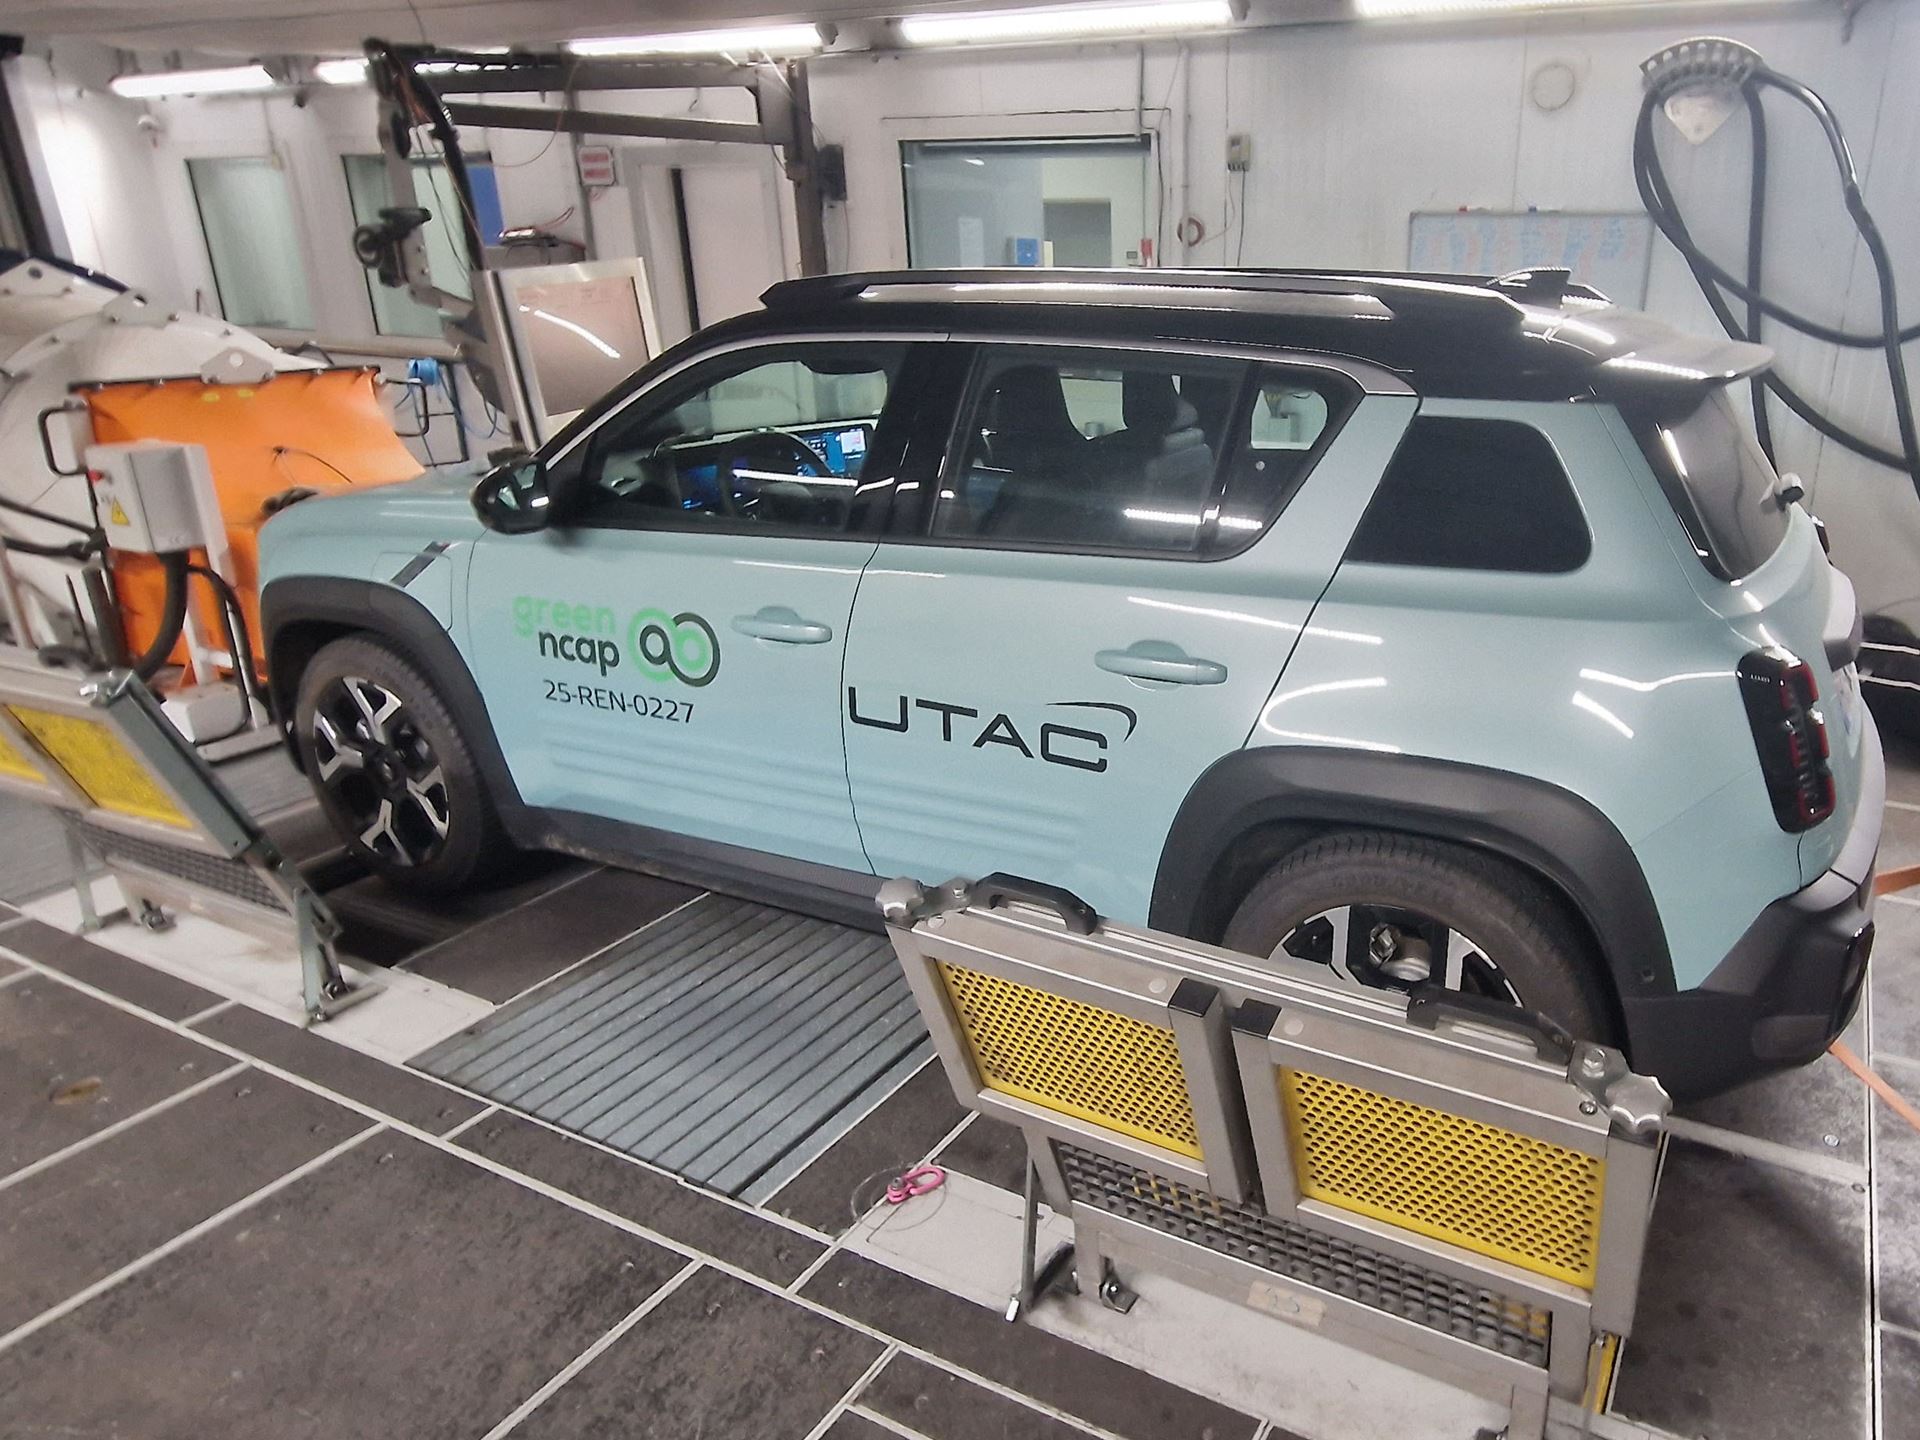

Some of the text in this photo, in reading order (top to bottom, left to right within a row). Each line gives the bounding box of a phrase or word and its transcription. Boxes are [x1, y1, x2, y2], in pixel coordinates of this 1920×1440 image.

[513, 595, 615, 638] green
[538, 631, 620, 677] ncap
[543, 679, 694, 723] 25-REN-0227
[848, 686, 1108, 774] UTAC
